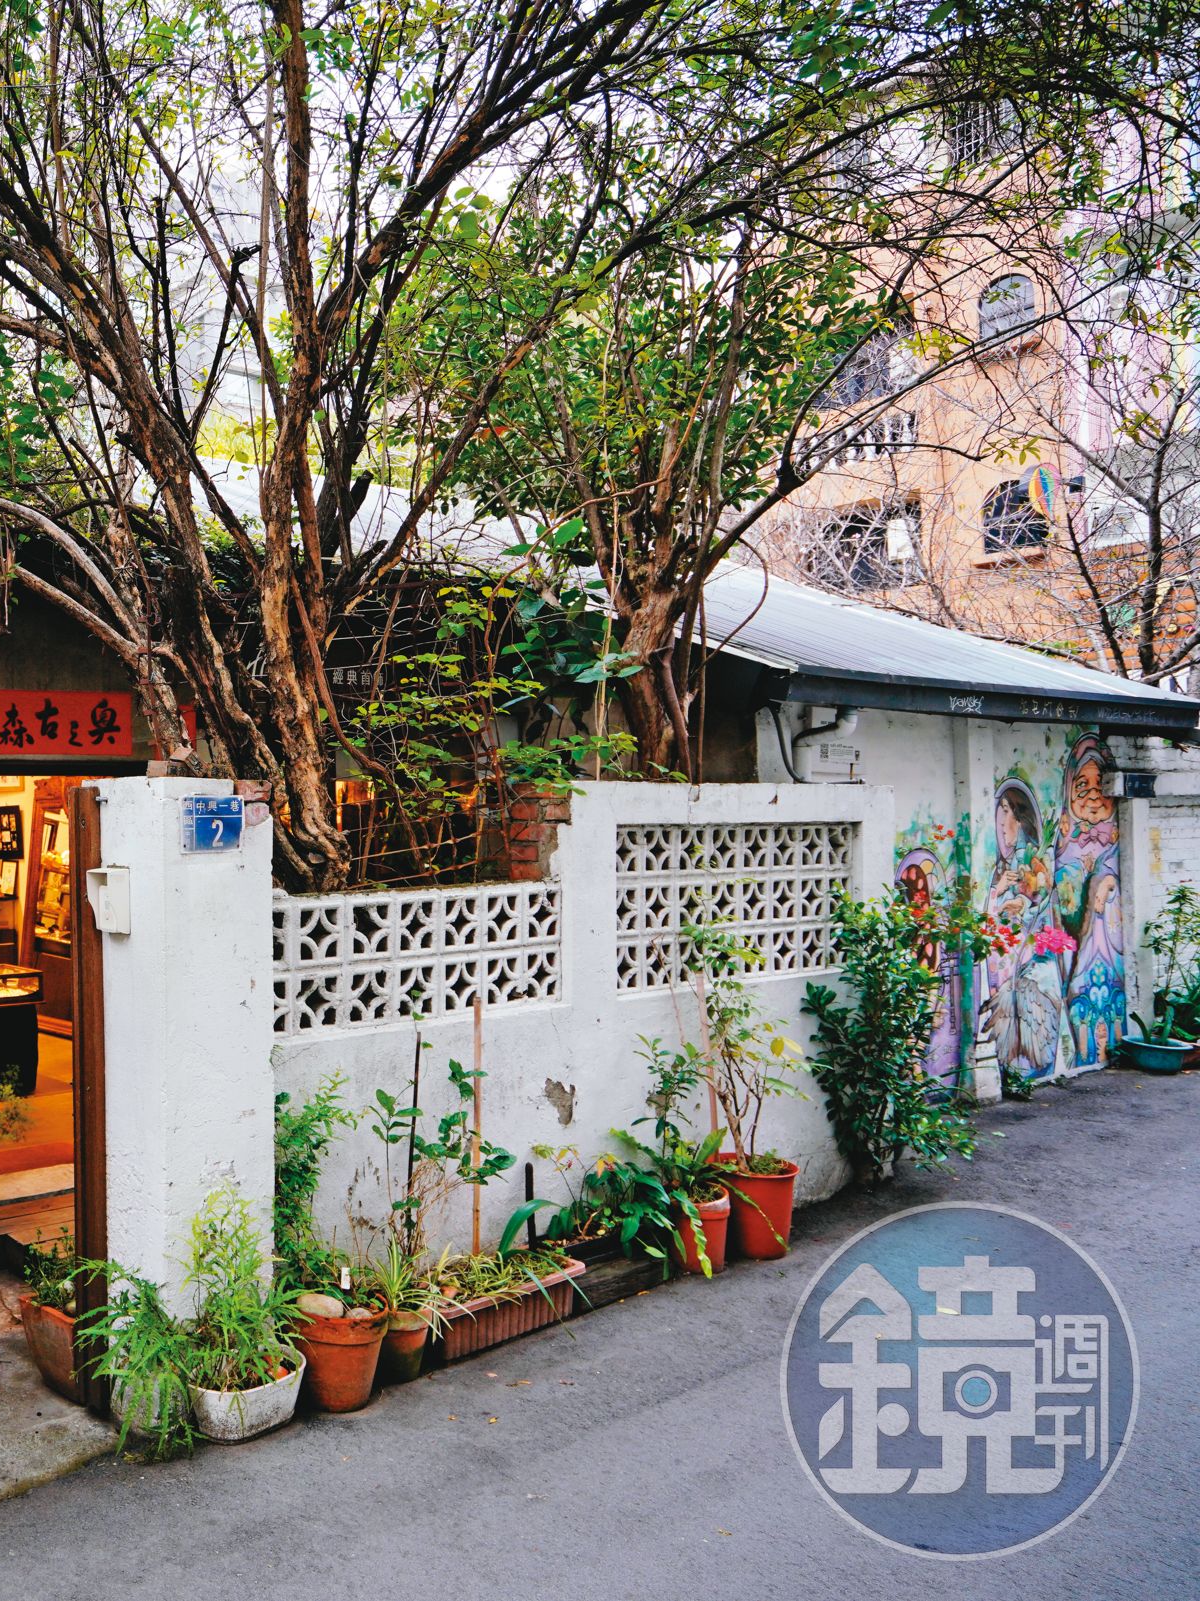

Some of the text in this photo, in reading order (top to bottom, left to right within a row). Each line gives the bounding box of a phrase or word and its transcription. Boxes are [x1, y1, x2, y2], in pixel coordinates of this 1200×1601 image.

[196, 800, 240, 812] 中興一巷
[211, 819, 224, 848] 2
